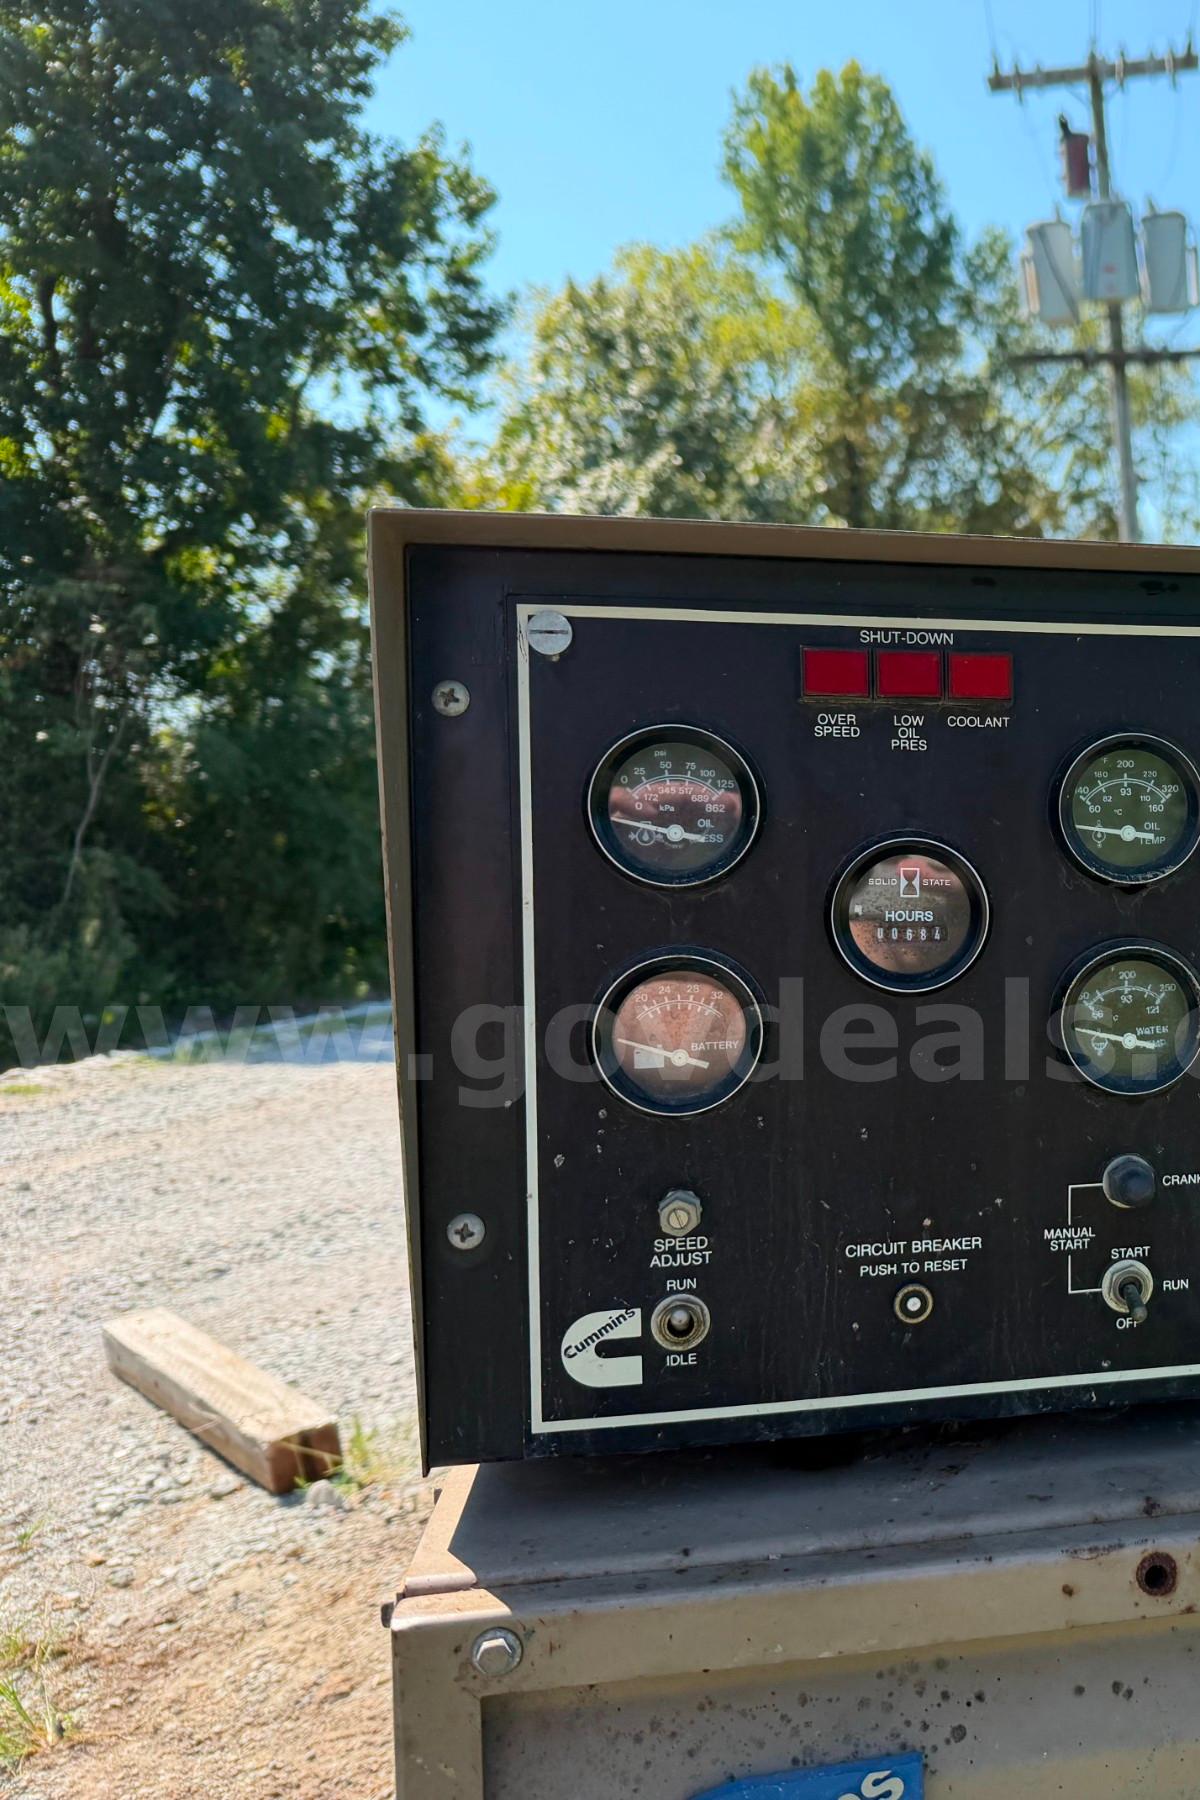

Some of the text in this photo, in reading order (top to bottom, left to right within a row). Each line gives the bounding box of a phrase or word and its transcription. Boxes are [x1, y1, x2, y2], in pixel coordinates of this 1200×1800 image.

[860, 630, 954, 645] SHUT-DOWN
[818, 714, 856, 725] OVER
[894, 715, 924, 726] LOW
[948, 716, 1010, 727] COOLANT
[814, 726, 860, 738] SPEED
[899, 728, 920, 738] OIL
[892, 740, 927, 750] PRES
[620, 776, 628, 784] 0
[1144, 822, 1160, 830] OIL
[885, 911, 933, 922] HOURS
[1119, 970, 1136, 979] 200
[635, 994, 648, 1002] 20
[687, 985, 700, 993] 28
[691, 1040, 739, 1051] BATTERY
[1044, 1227, 1096, 1240] MANUAL
[654, 1236, 708, 1251] SPEED
[845, 1237, 982, 1258] CIRCUIT BREAKER
[1050, 1238, 1090, 1251] START
[1111, 1246, 1150, 1259] START
[650, 1251, 712, 1268] ADJUST
[860, 1259, 968, 1277] PUSH TO RESET
[666, 1278, 697, 1291] RUN
[1163, 1279, 1189, 1291] RUN
[563, 1308, 636, 1359] Cummins
[666, 1353, 697, 1366] IDLE
